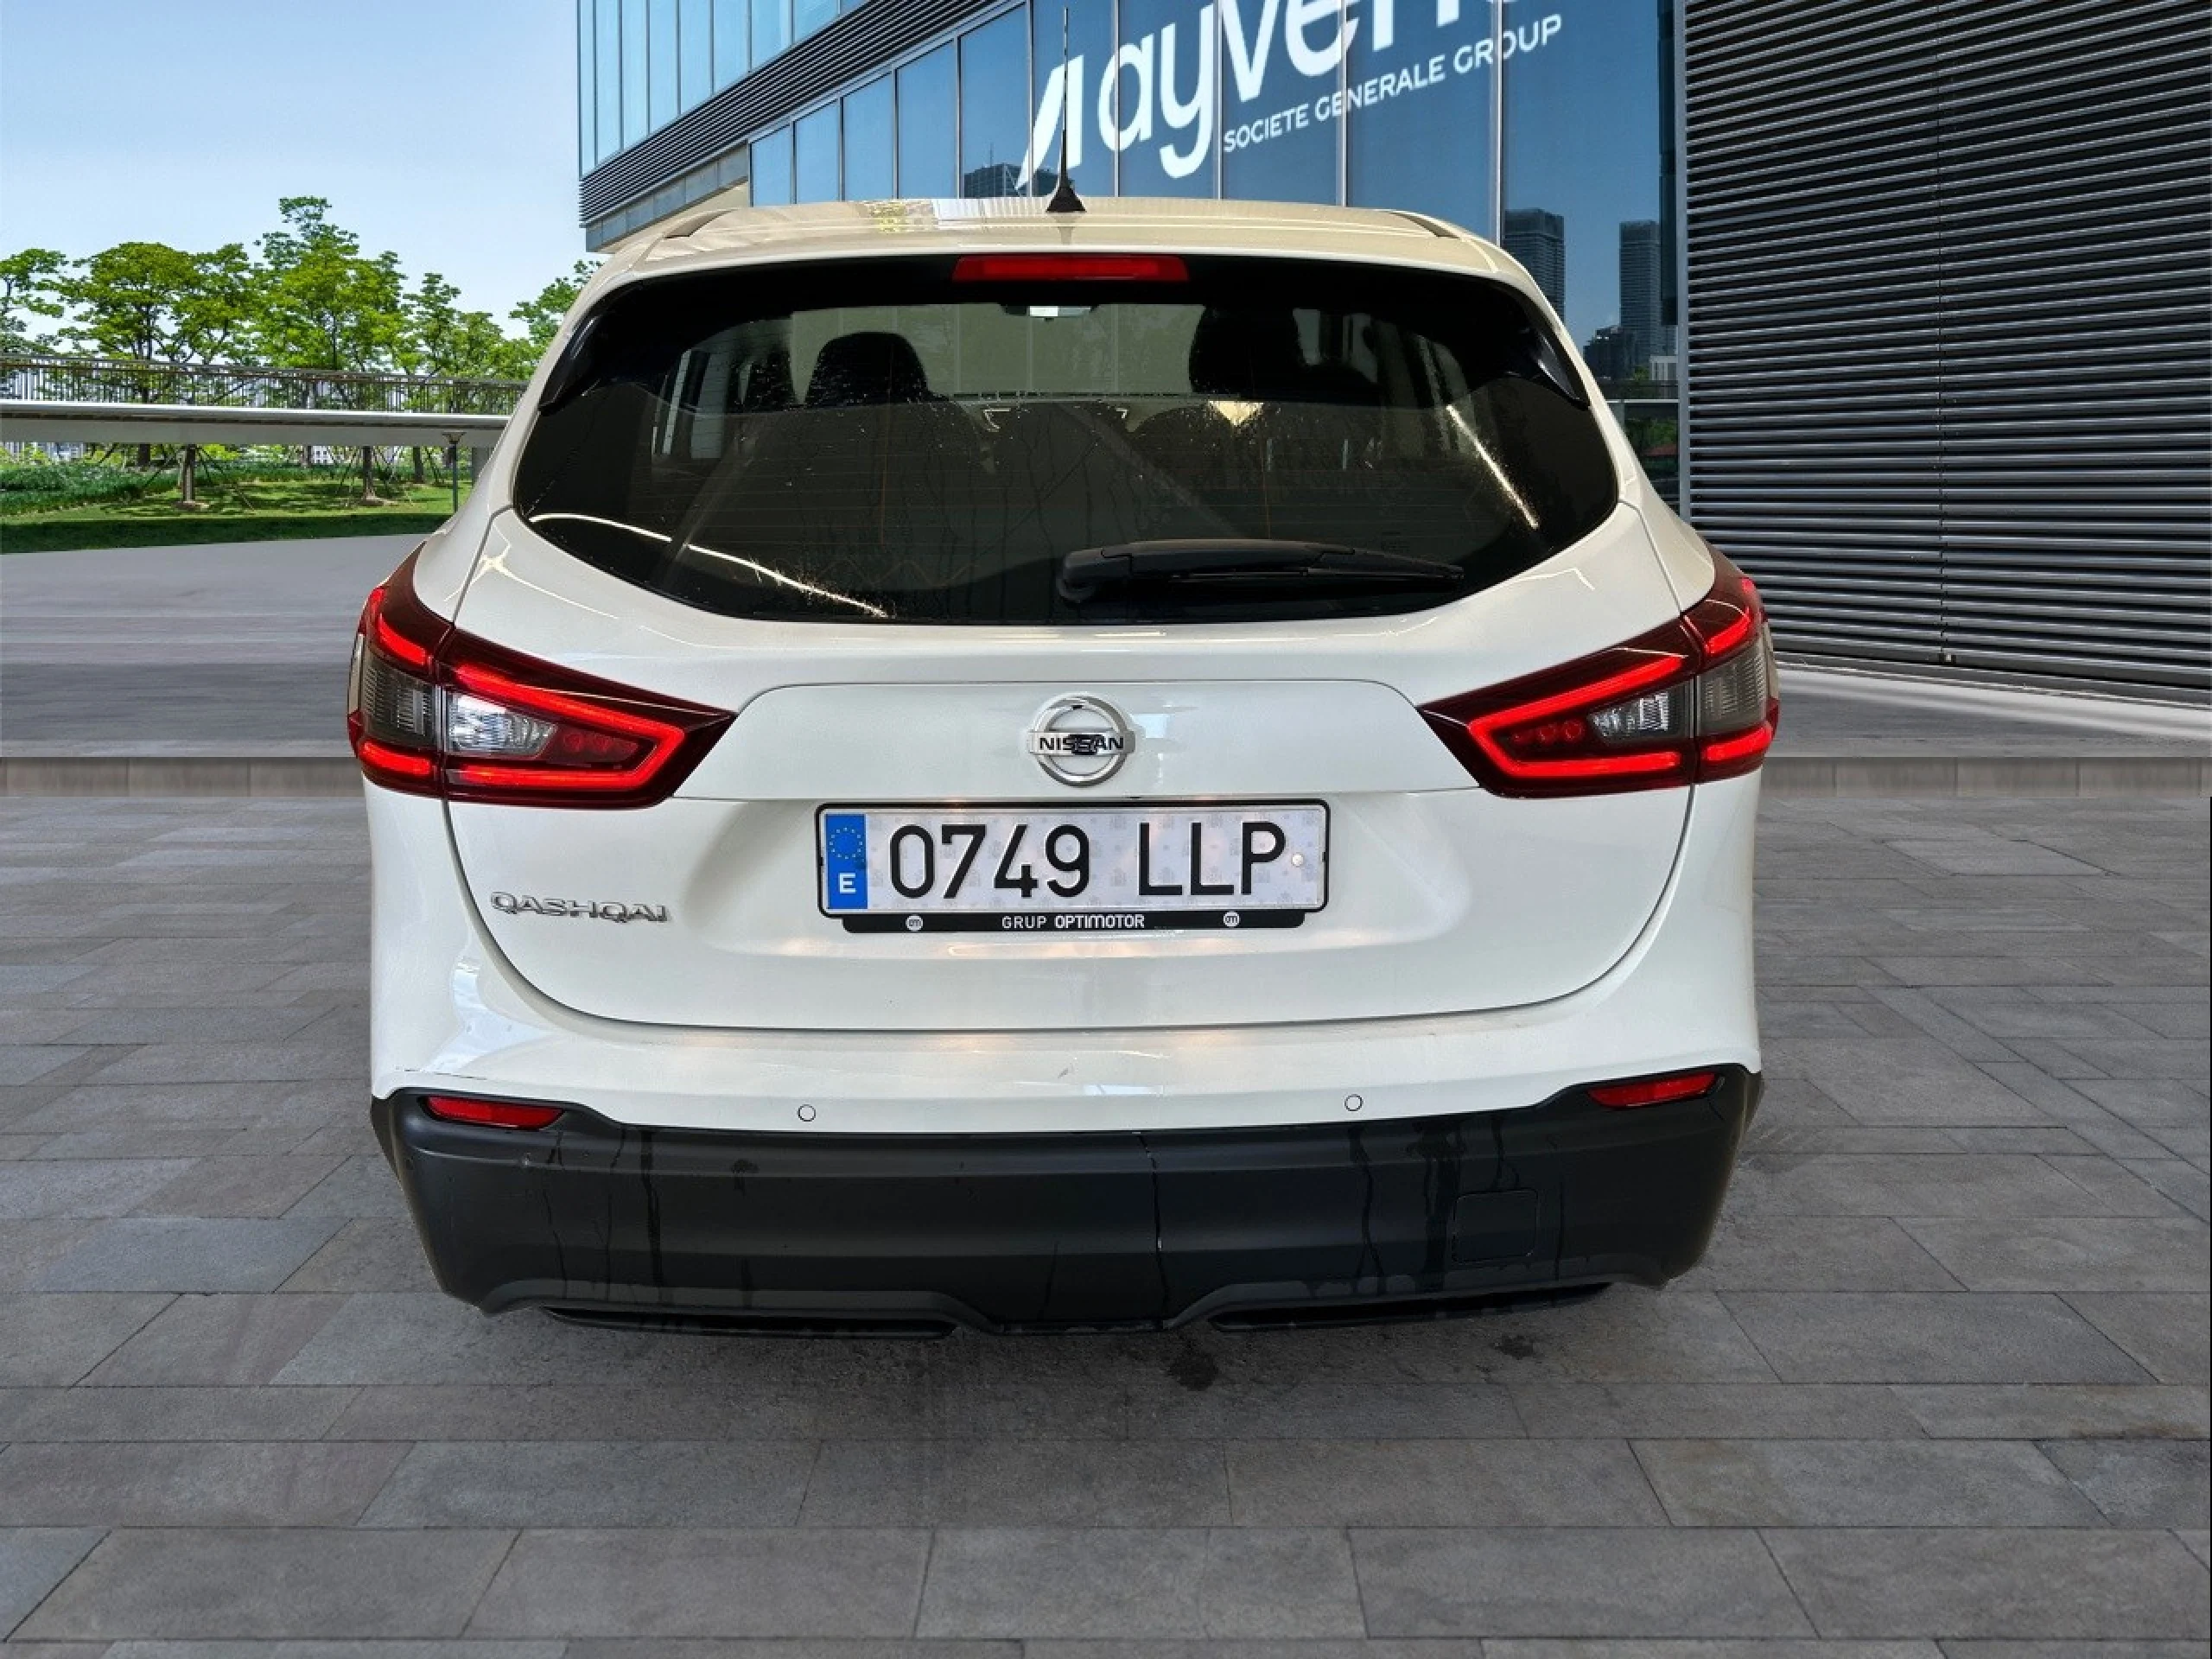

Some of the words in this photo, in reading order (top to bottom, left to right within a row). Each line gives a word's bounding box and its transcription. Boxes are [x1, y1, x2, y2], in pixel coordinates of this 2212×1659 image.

[1223, 103, 1309, 153] SOCIETE
[1314, 54, 1446, 123] GENERALE
[1452, 13, 1563, 75] GROUP
[1039, 736, 1123, 751] NISSAN
[889, 823, 1090, 899] 0749
[1138, 821, 1287, 896] LLP
[838, 873, 856, 894] E
[490, 891, 667, 923] QASHQAI
[1001, 916, 1046, 929] GRUP
[1054, 913, 1145, 929] OPTIMOTOR
